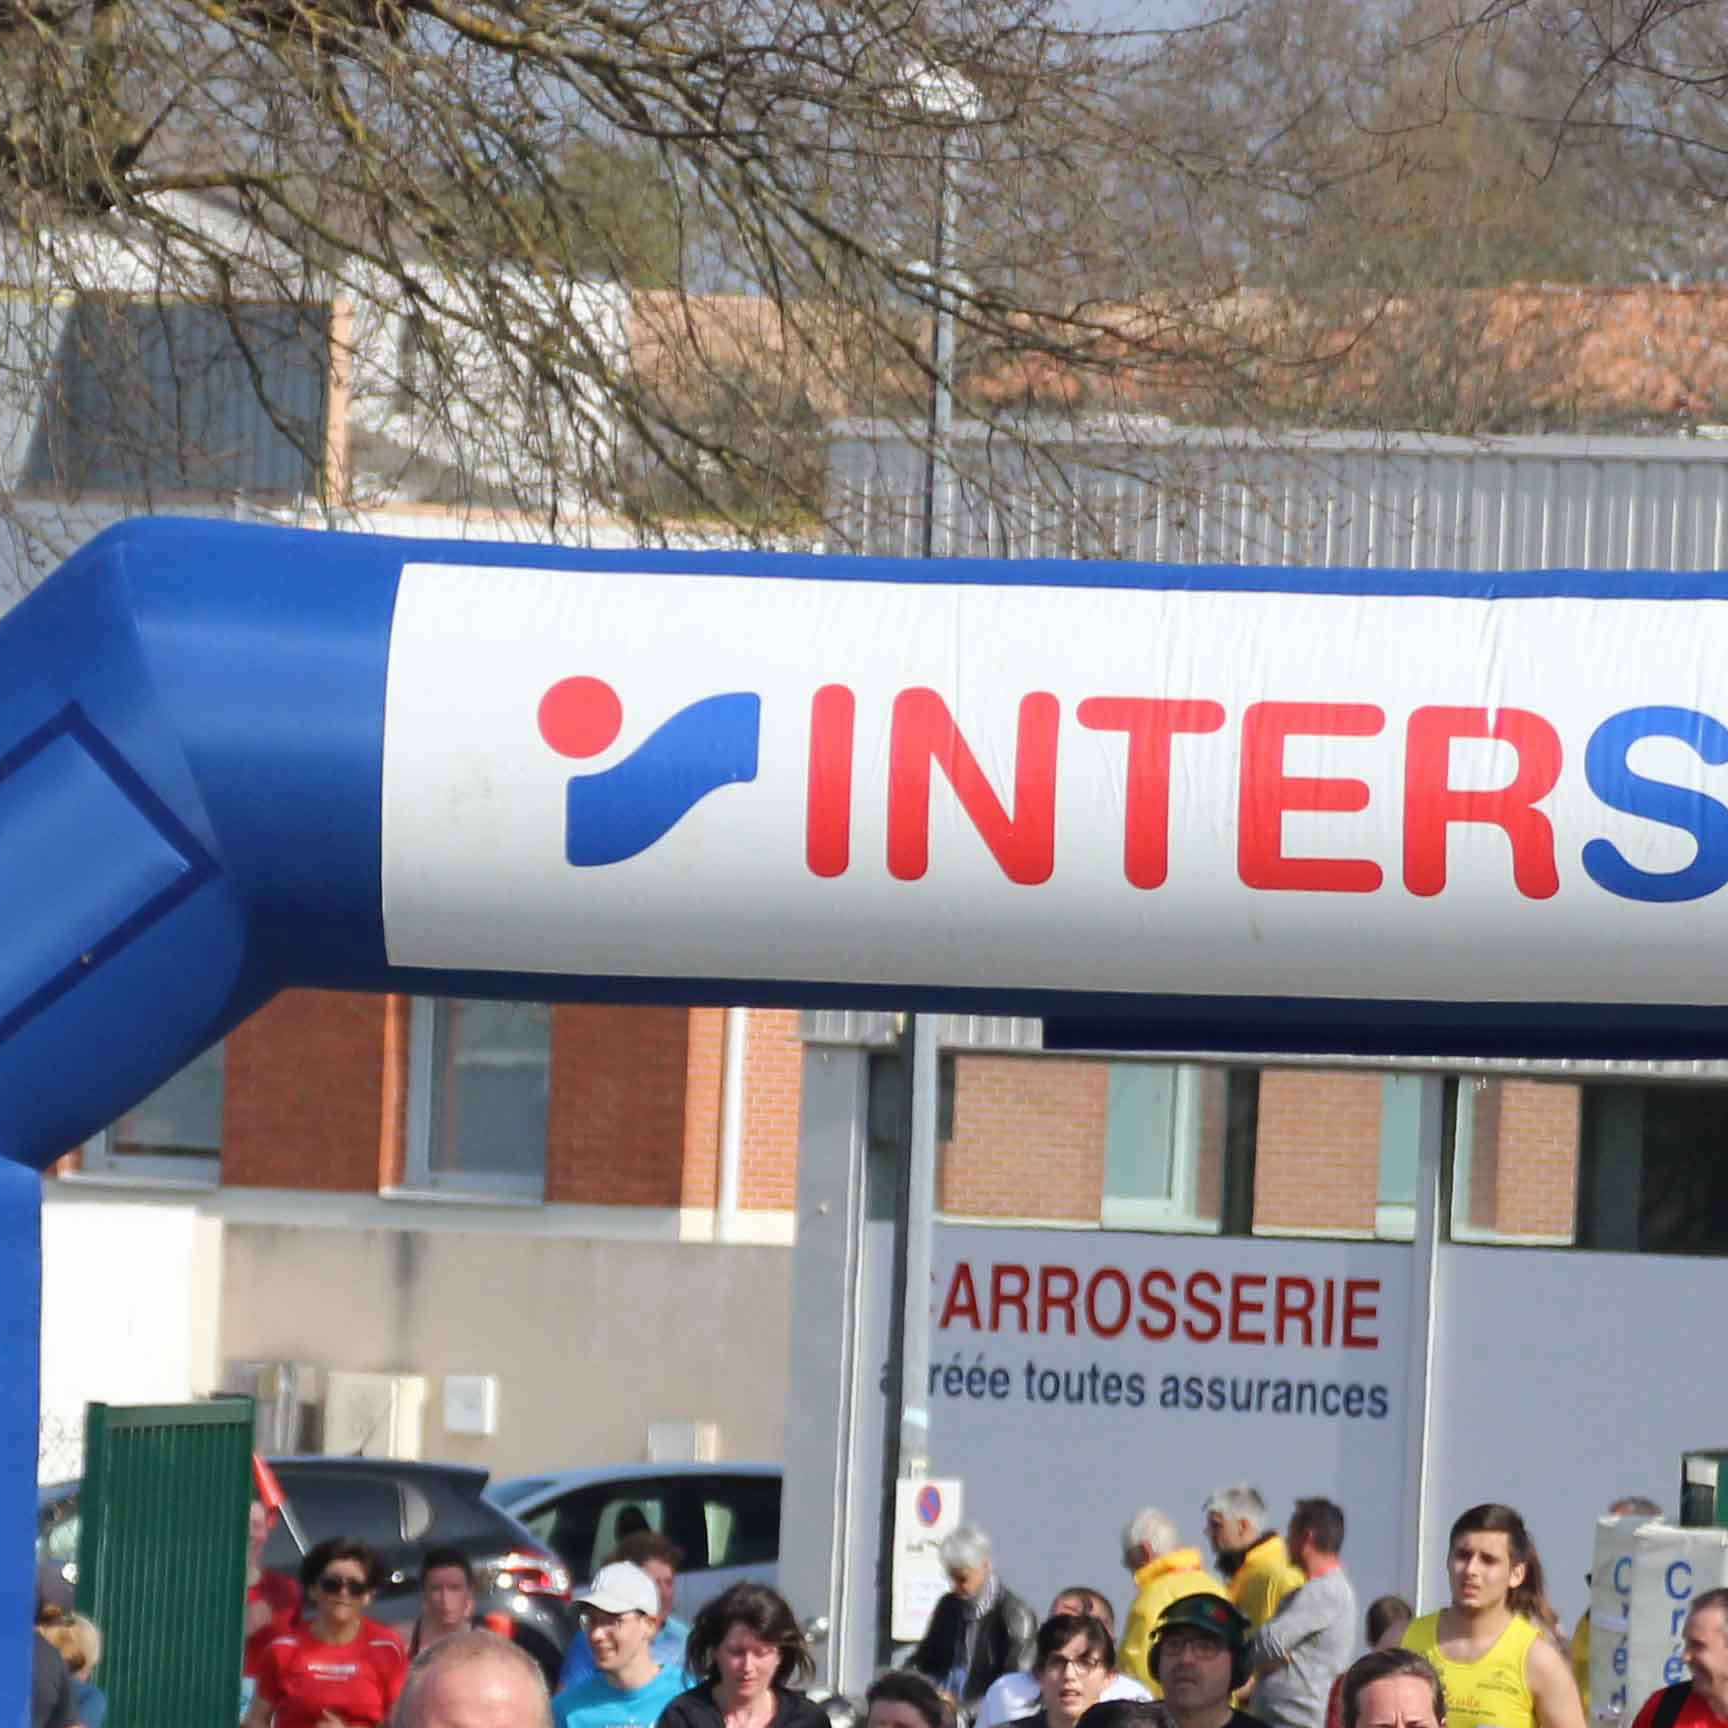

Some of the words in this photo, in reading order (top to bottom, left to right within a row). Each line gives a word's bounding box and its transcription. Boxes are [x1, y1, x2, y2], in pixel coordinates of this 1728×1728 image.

[929, 1261, 1382, 1350] ARROSSERIE
[1024, 1359, 1147, 1408] toutes
[1158, 1372, 1390, 1421] assurances
